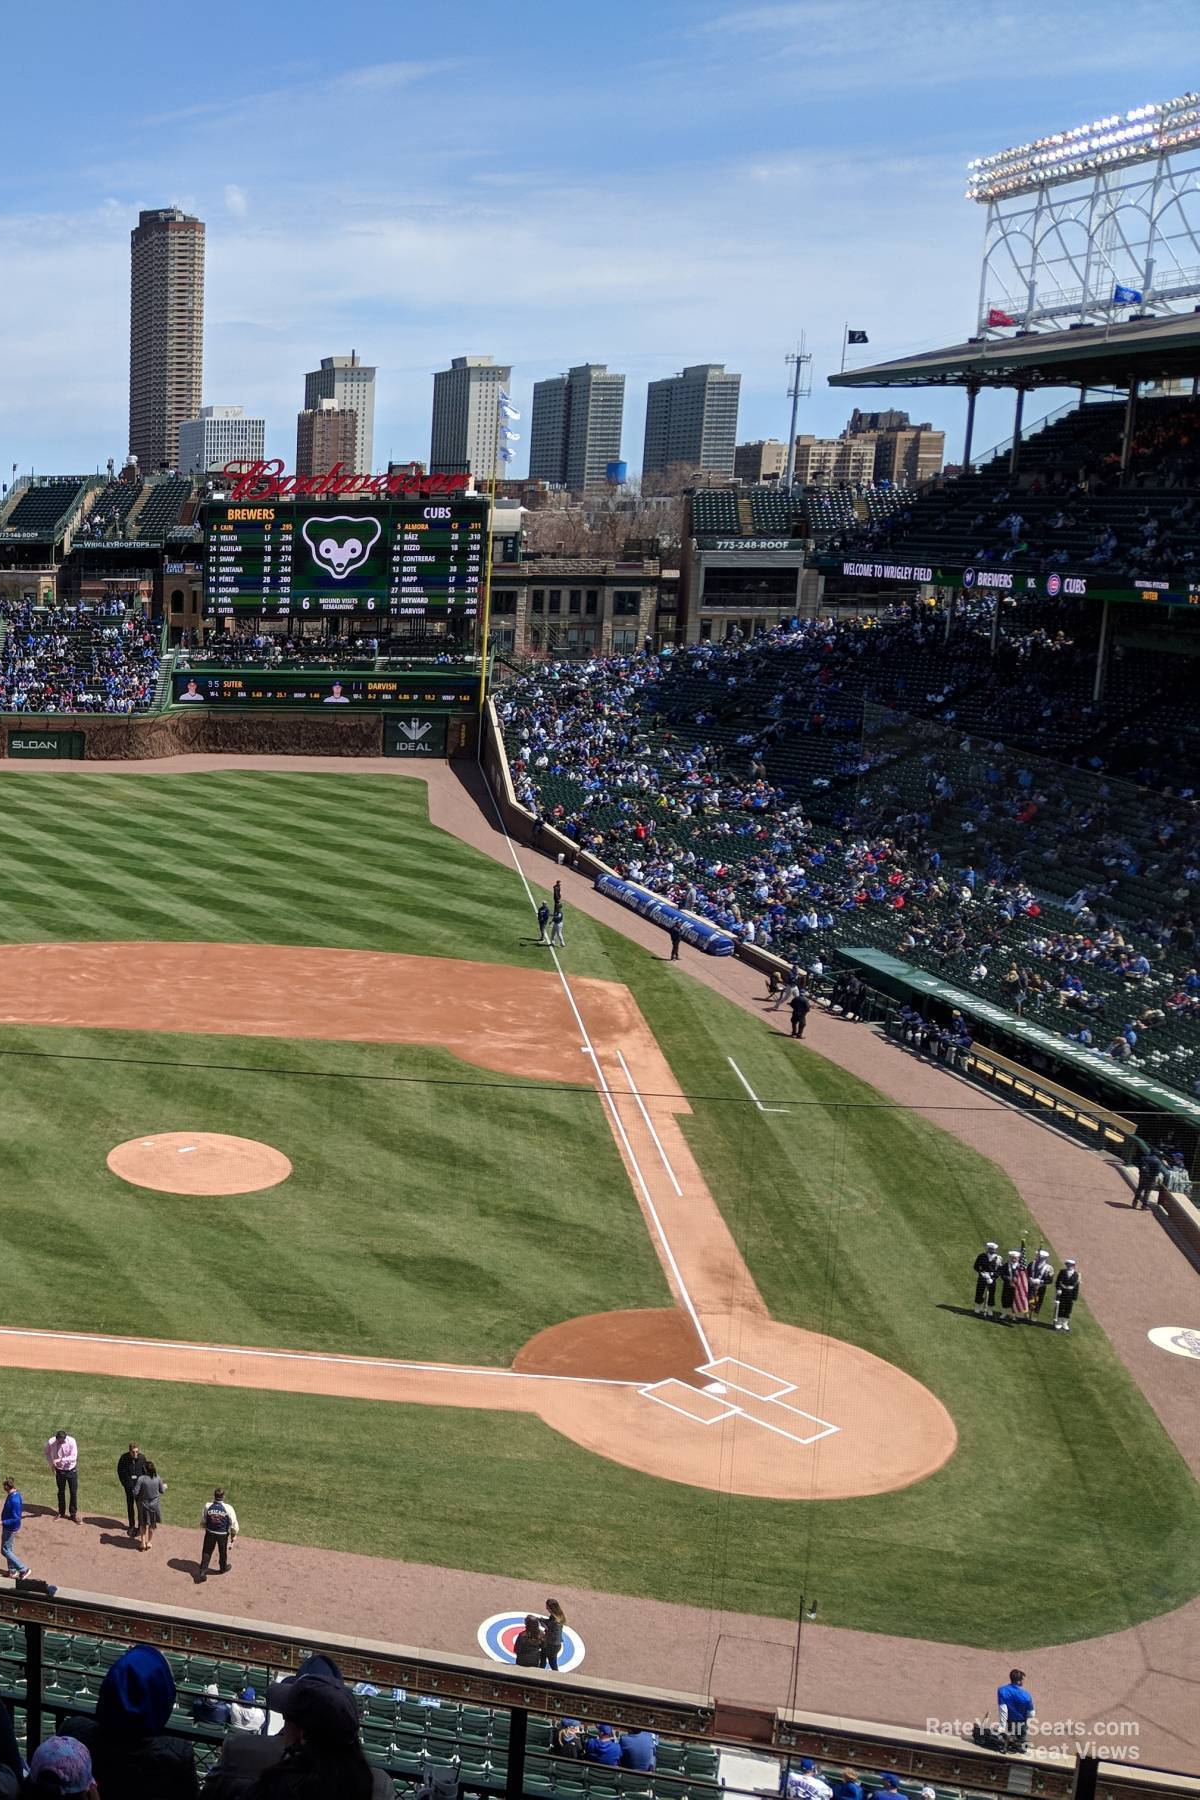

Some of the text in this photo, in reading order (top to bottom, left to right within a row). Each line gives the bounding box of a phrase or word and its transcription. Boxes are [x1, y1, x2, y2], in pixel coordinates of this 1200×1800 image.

[224, 459, 472, 501] Budweiser
[227, 508, 275, 520] BREWERS
[423, 507, 452, 519] CUBS
[717, 541, 789, 550] 773-248-ROOF
[843, 562, 932, 582] WELCOME TO WRIGLEY FIELD
[977, 572, 1013, 588] BREWERS
[1064, 578, 1087, 595] CUBS
[302, 597, 310, 610] 6
[367, 597, 375, 610] 6
[208, 680, 243, 688] 35 SUTER
[368, 682, 397, 691] DARVISH
[11, 740, 57, 750] SLOAN
[396, 742, 433, 751] IDEAL
